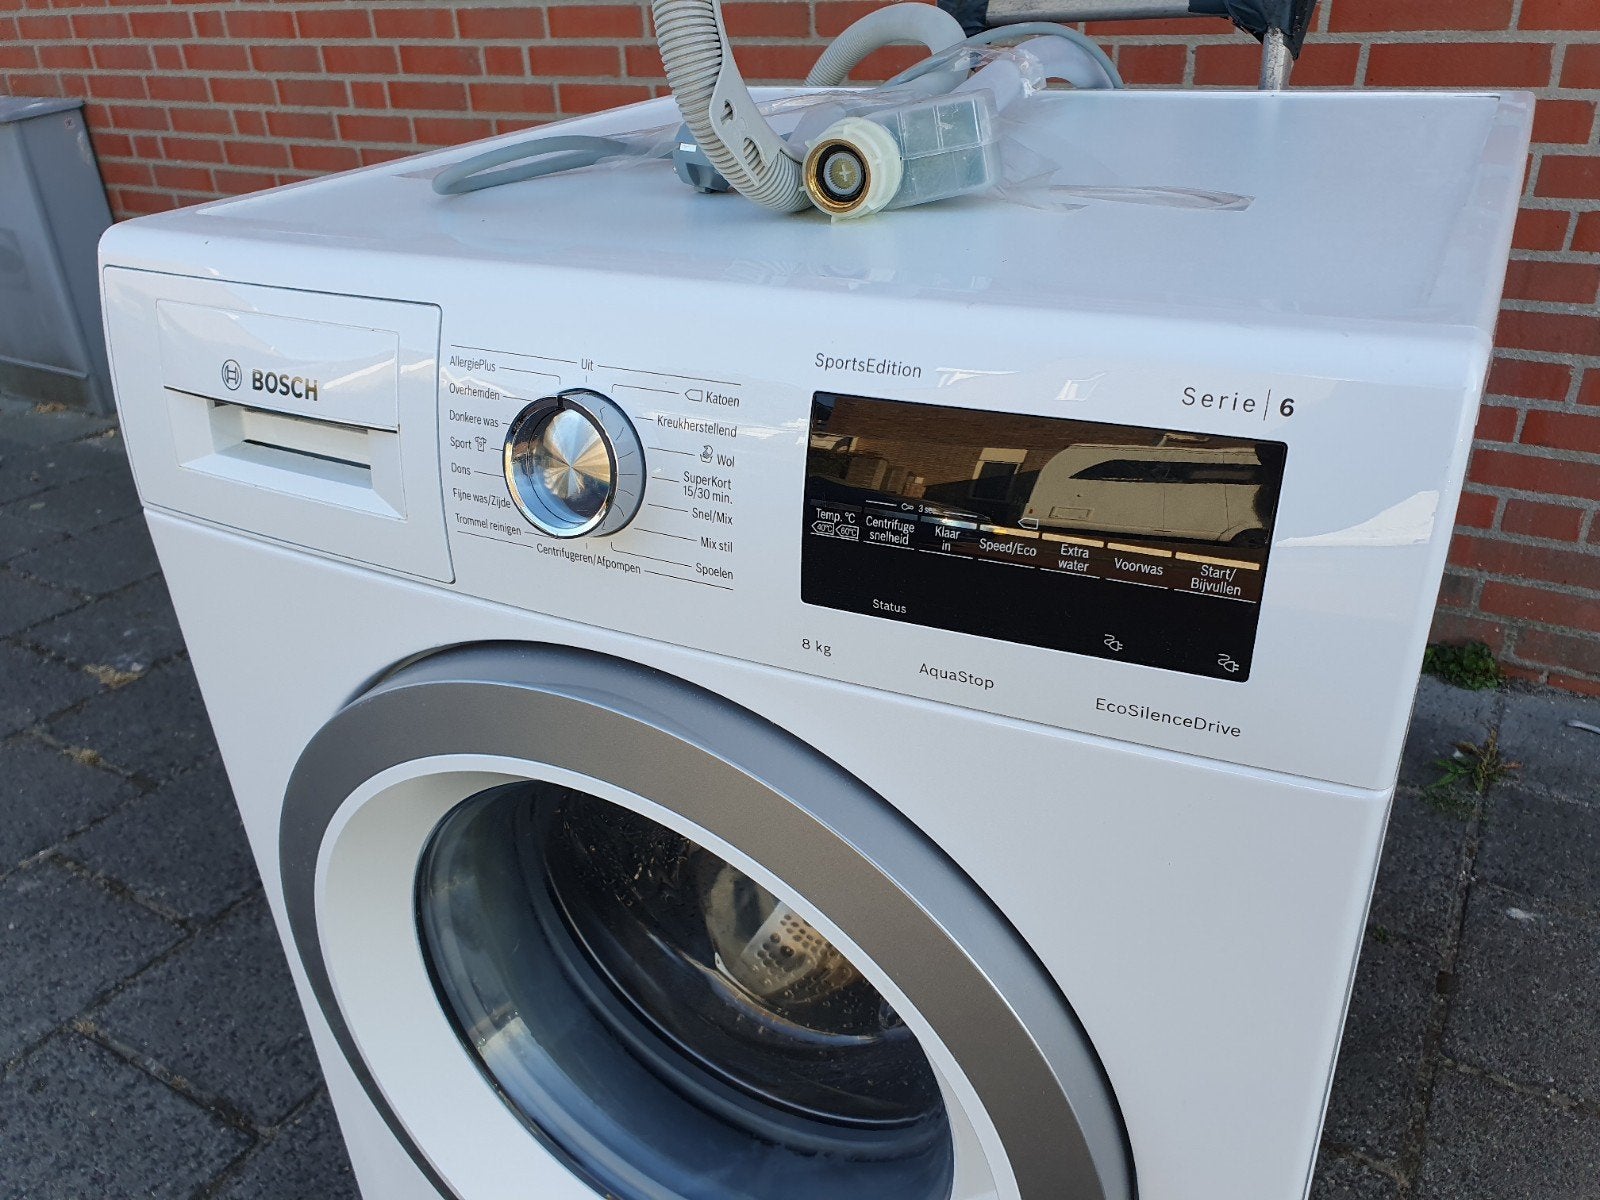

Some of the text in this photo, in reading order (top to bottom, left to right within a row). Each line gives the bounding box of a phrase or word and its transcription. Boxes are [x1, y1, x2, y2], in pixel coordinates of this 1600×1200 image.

[449, 355, 496, 373] AllergiePlus
[581, 358, 594, 371] Uit
[814, 352, 922, 378] SportsEdition
[252, 368, 318, 401] BOSCH
[449, 382, 500, 401] Overhemden
[706, 391, 740, 408] Katoen
[1181, 387, 1295, 417] Serie 6
[449, 409, 499, 428] Donkere was
[657, 415, 738, 438] Kreukherstellend
[450, 437, 472, 450] Sport
[451, 462, 471, 476] Dons
[717, 454, 735, 467] Wol
[683, 470, 732, 490] SuperKort
[452, 487, 511, 509] Fijne was/Zijde
[683, 485, 733, 504] 15/30 min.
[455, 512, 522, 536] Trommel reinigen
[692, 507, 733, 525] Snel/Mix
[816, 507, 843, 523] Temp.
[865, 516, 915, 534] Centrifuge
[934, 525, 960, 541] Klaar
[700, 536, 733, 553] Mix stil
[869, 530, 909, 545] snelheid
[941, 540, 951, 551] in
[979, 538, 1037, 557] Speed/Eco
[1060, 544, 1090, 559] Extra
[536, 543, 641, 574] Centrifugeren/Afpompen
[1058, 558, 1089, 573] water
[1114, 557, 1163, 576] Voorwas
[695, 562, 734, 580] Spoelen
[1200, 565, 1237, 581] Start/
[1191, 577, 1241, 597] Bijvullen
[872, 598, 907, 614] Status
[801, 638, 832, 657] 8 kg
[918, 662, 995, 690] AquaStop
[1095, 697, 1242, 737] EcoSilenceDrive
